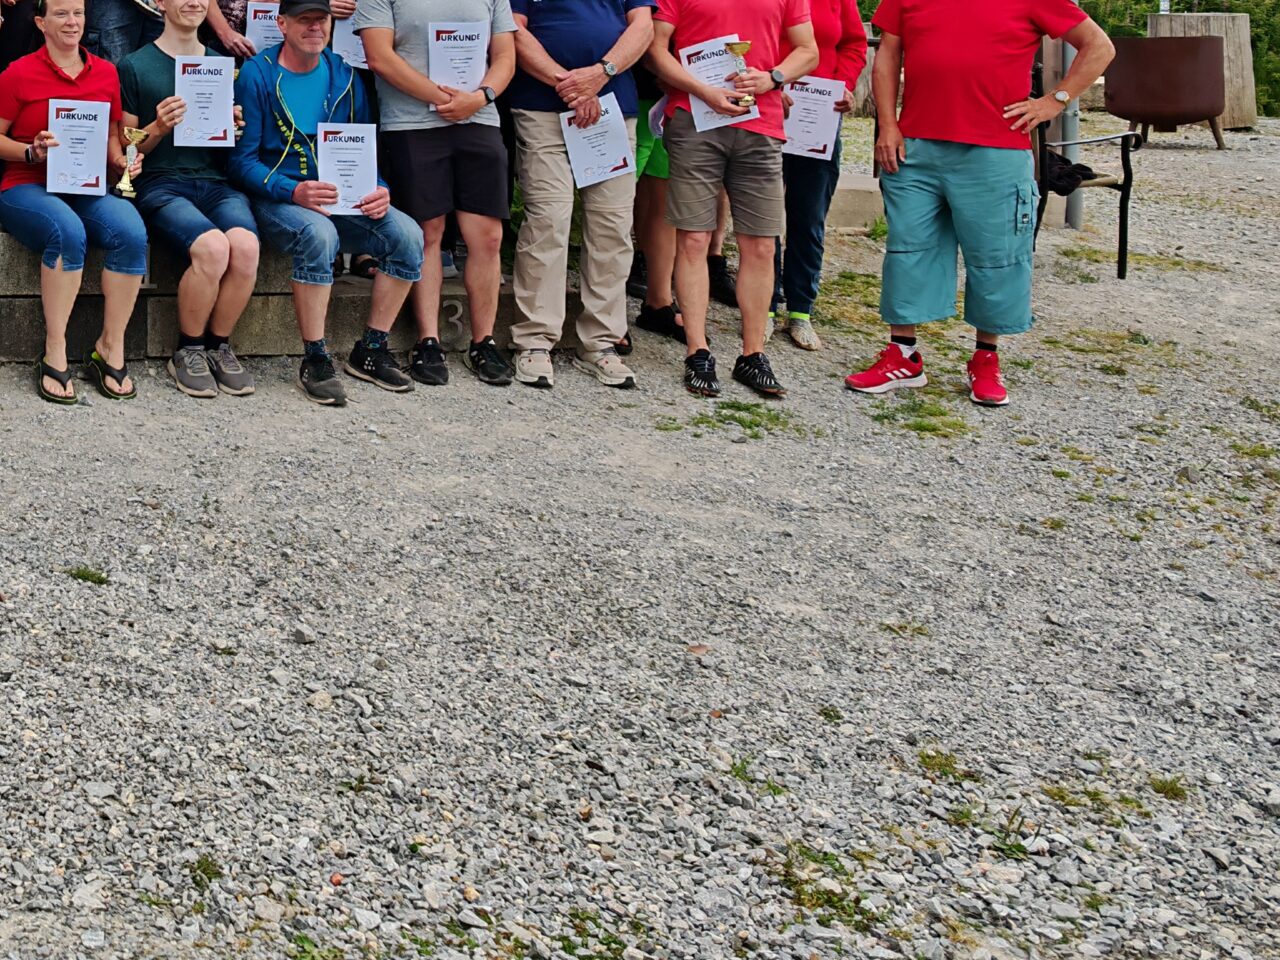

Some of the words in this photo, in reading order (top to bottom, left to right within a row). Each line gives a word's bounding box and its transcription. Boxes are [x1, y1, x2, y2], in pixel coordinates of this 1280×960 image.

[440, 33, 481, 42] URKUNDE
[186, 68, 224, 76] URKUNDE
[794, 85, 832, 97] URKUNDE
[60, 112, 98, 121] URKUNDE
[442, 299, 463, 339] 3
